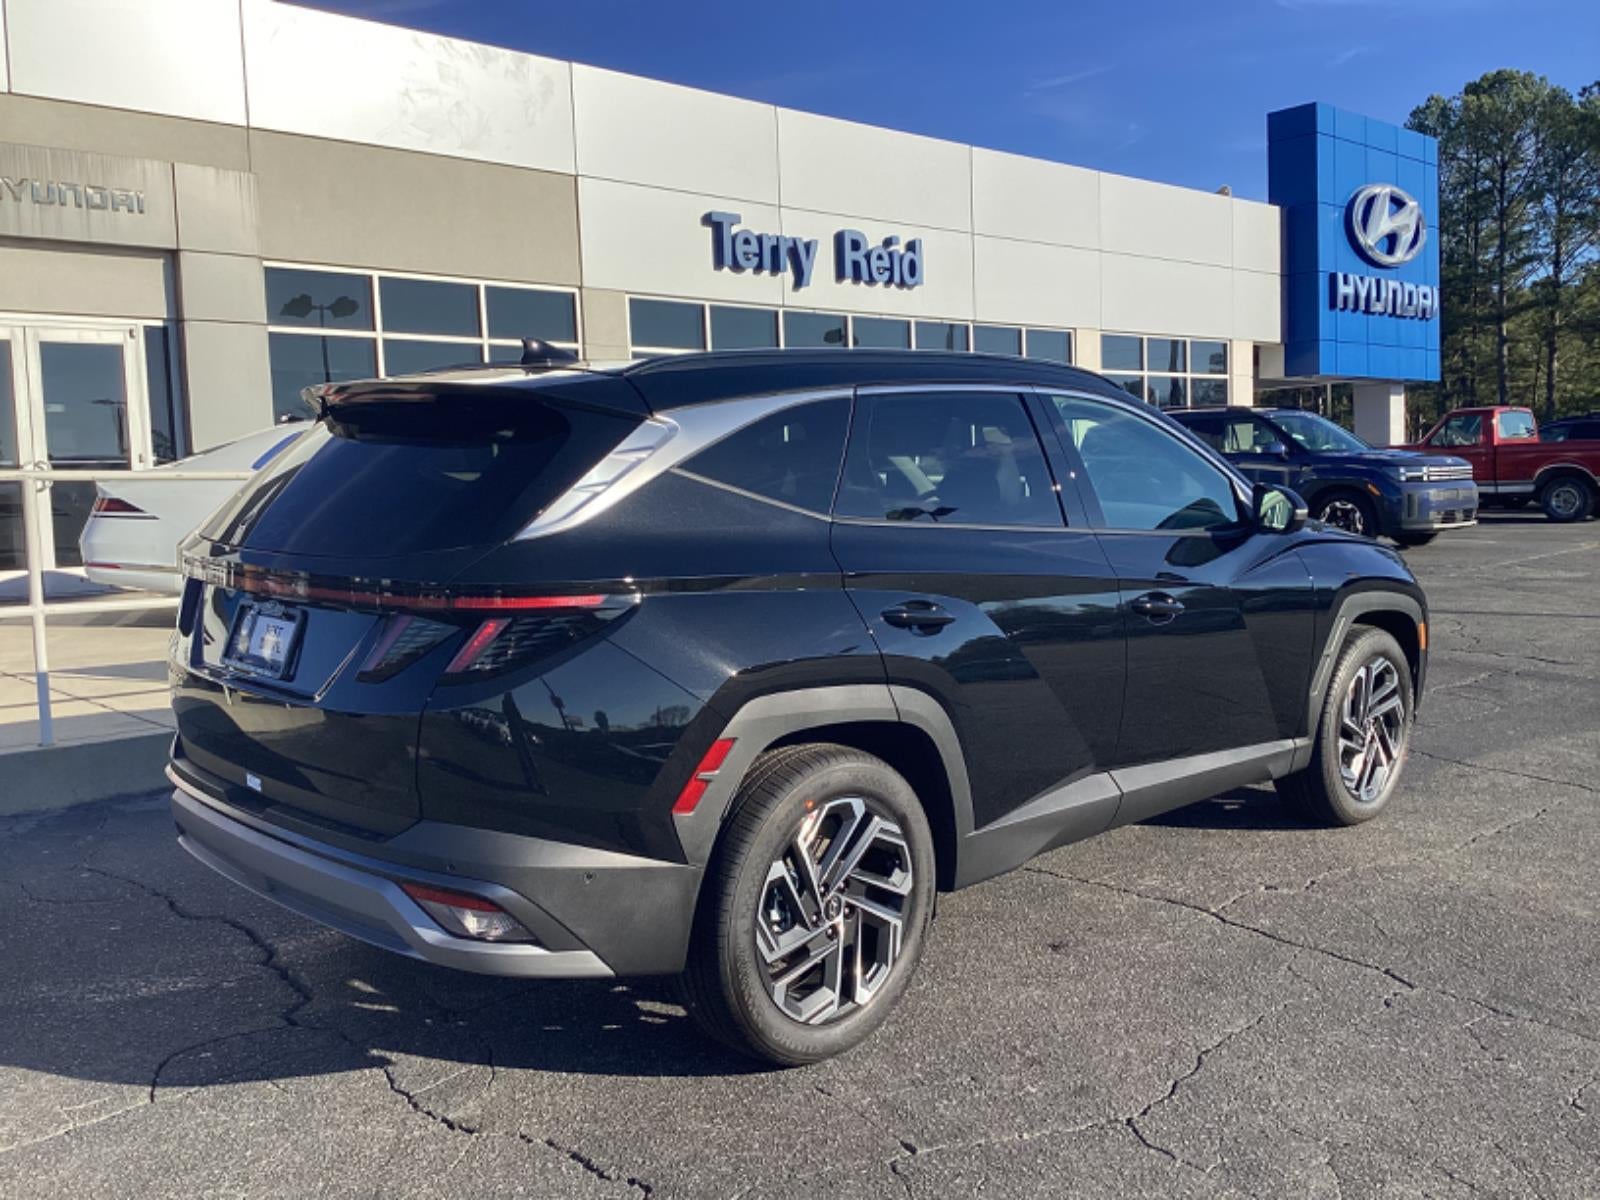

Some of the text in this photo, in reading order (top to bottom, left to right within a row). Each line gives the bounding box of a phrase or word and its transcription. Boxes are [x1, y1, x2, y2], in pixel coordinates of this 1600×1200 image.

[0, 176, 145, 214] YUNDAI
[701, 210, 924, 292] Terry Reid
[1330, 272, 1440, 321] HYUNDAI
